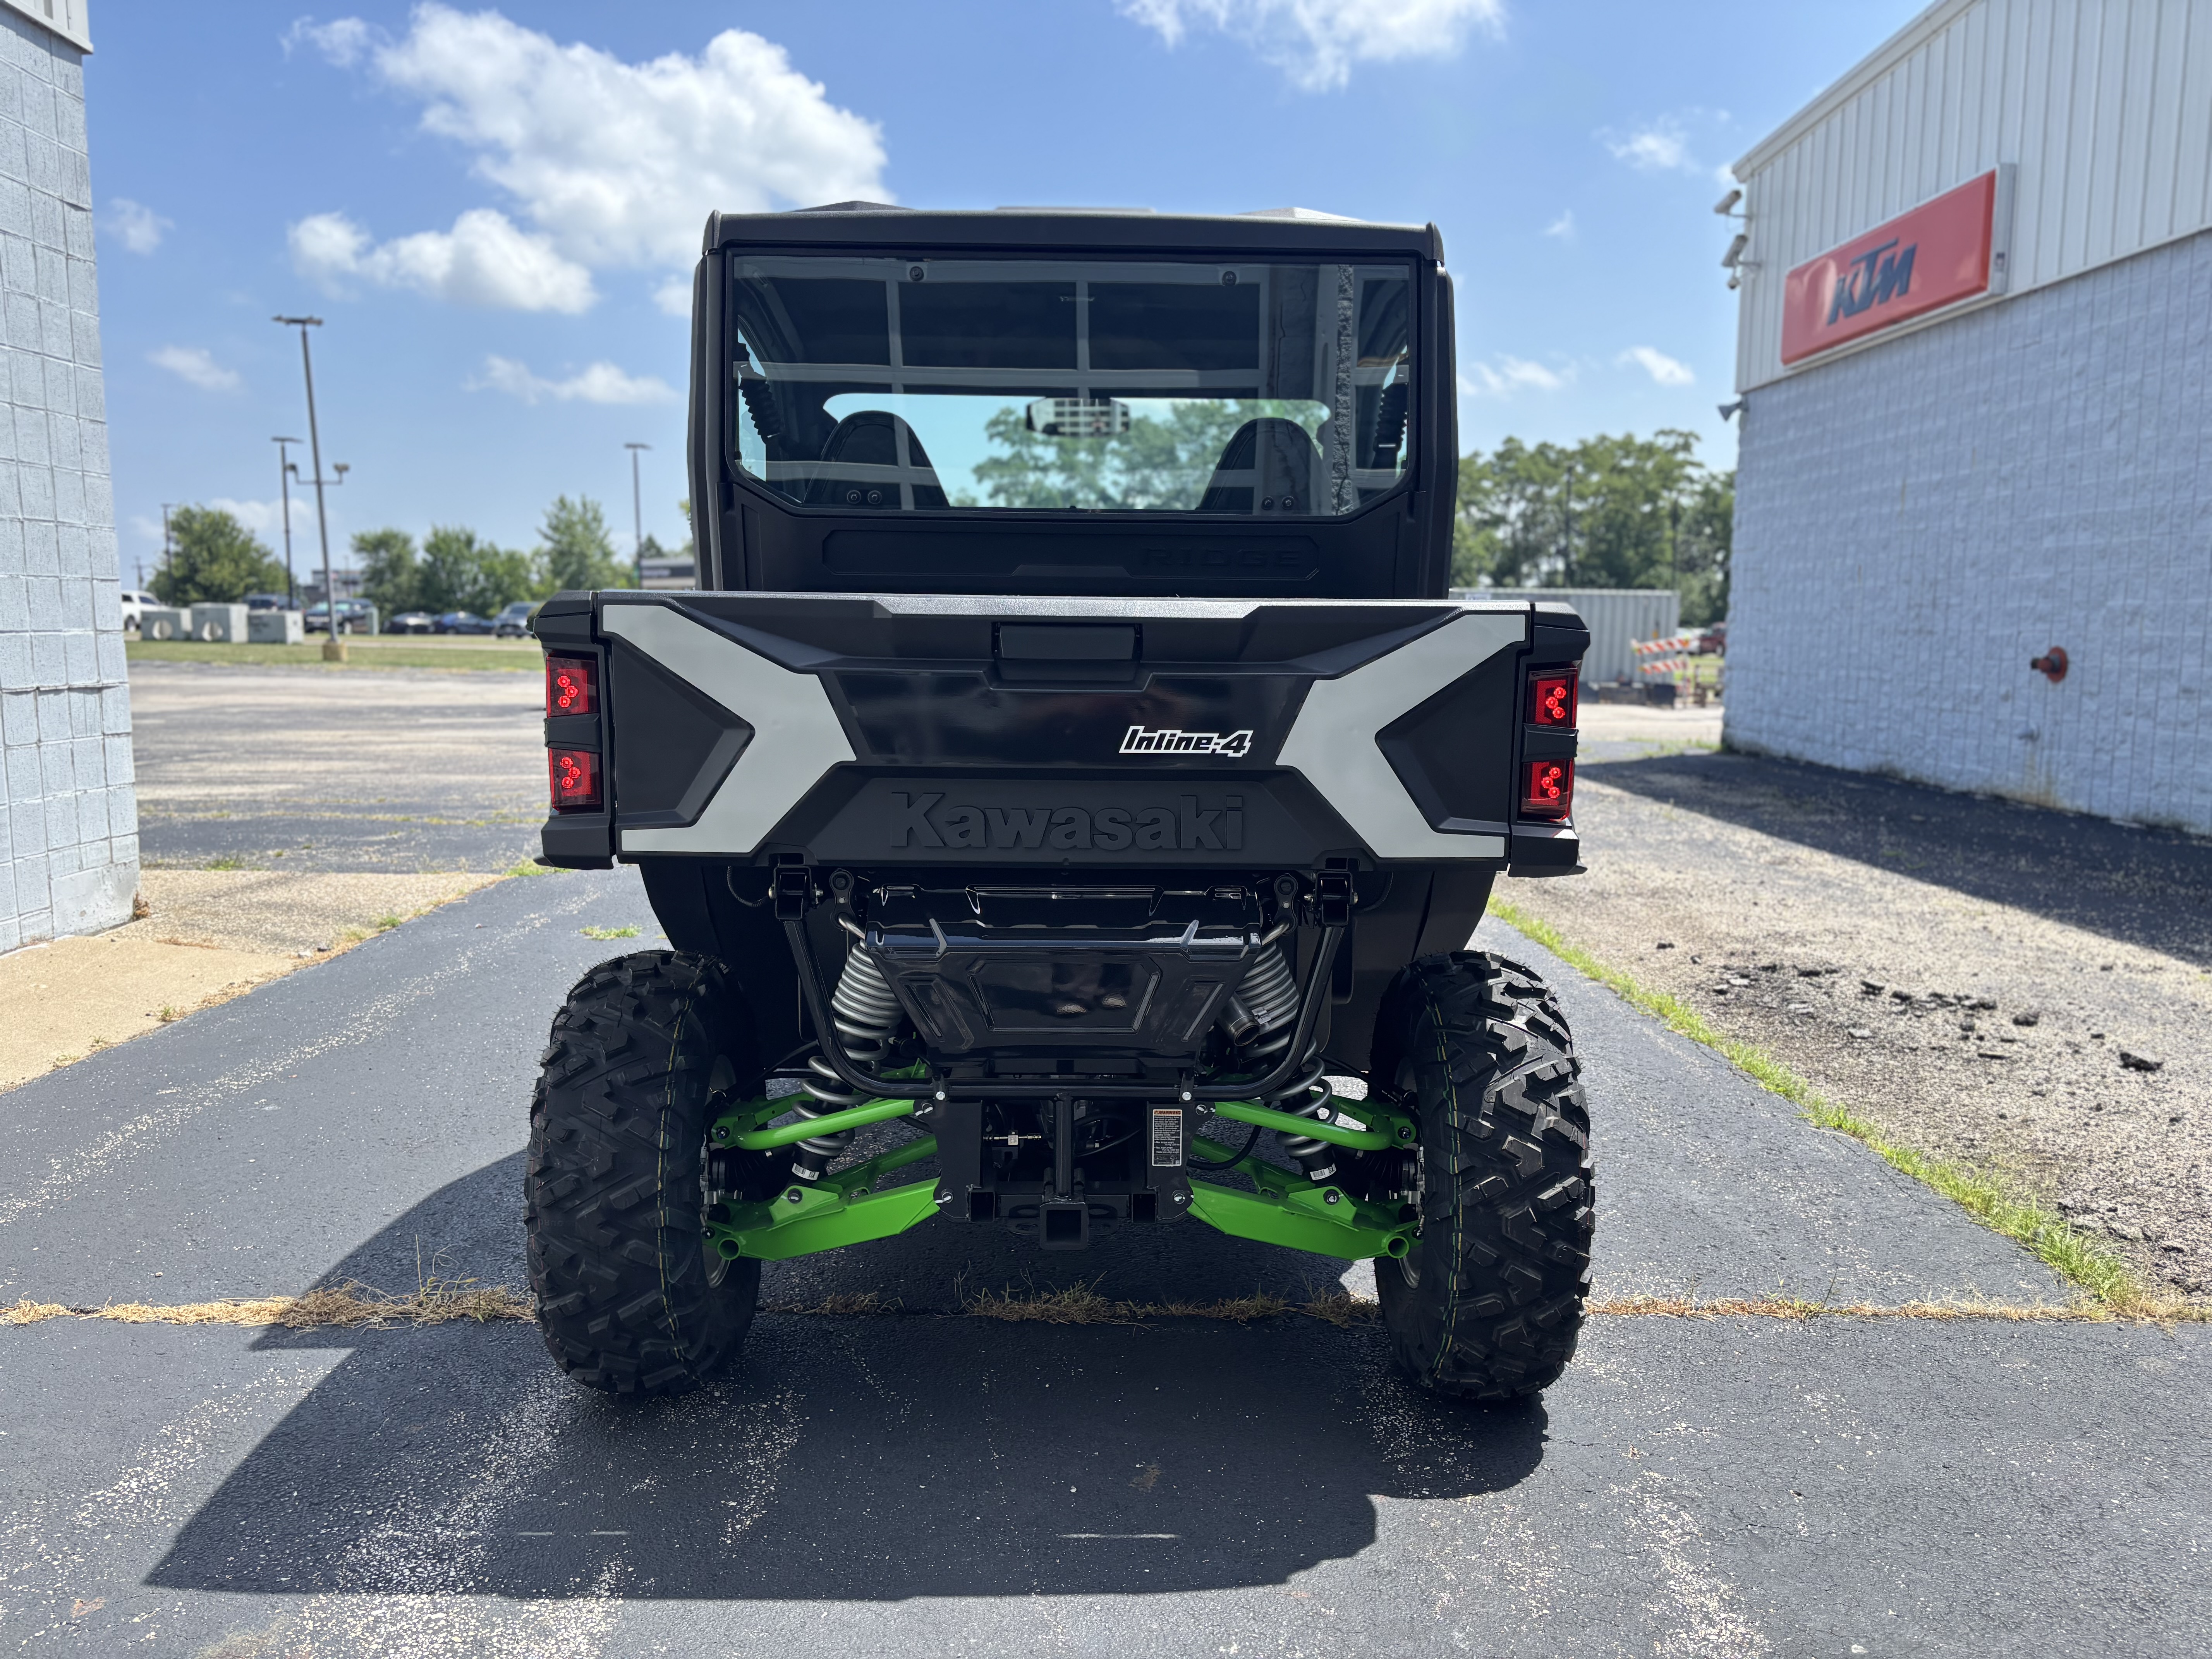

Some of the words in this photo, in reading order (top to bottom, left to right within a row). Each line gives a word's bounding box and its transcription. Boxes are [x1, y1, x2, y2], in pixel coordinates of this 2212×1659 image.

[1826, 237, 1918, 327] KTM
[1141, 548, 1300, 567] RIDGE
[1119, 726, 1254, 757] Inline-4
[890, 792, 1243, 850] Kawasaki
